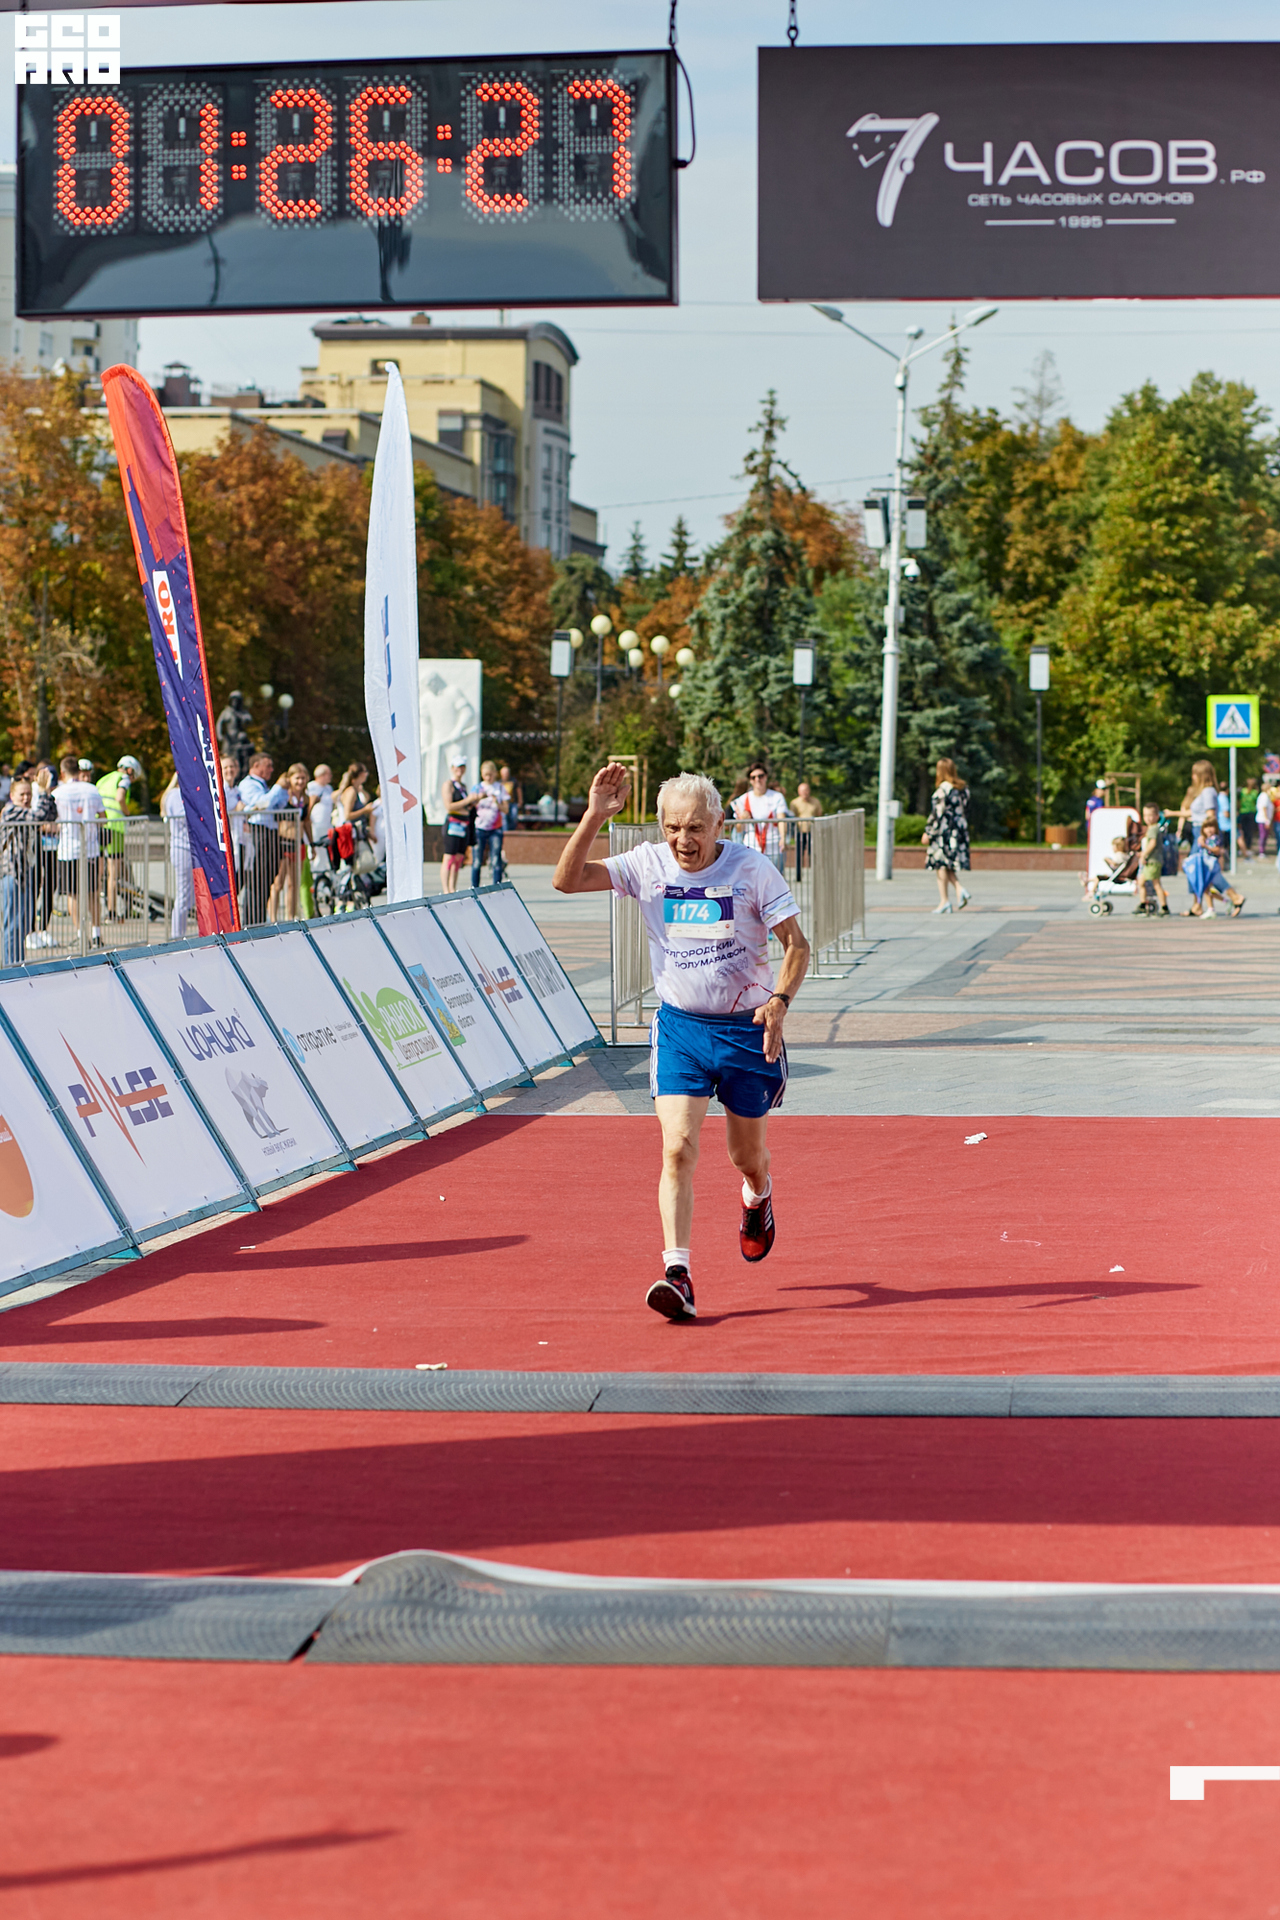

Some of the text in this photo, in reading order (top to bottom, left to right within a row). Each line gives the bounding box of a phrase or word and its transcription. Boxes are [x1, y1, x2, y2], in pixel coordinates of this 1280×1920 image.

[56, 79, 633, 225] 01:26:27
[967, 192, 1195, 206] СЕТЬ ЧАСОВЫХ САЛОНОВ
[1058, 215, 1103, 228] 1995
[672, 903, 710, 921] 1174
